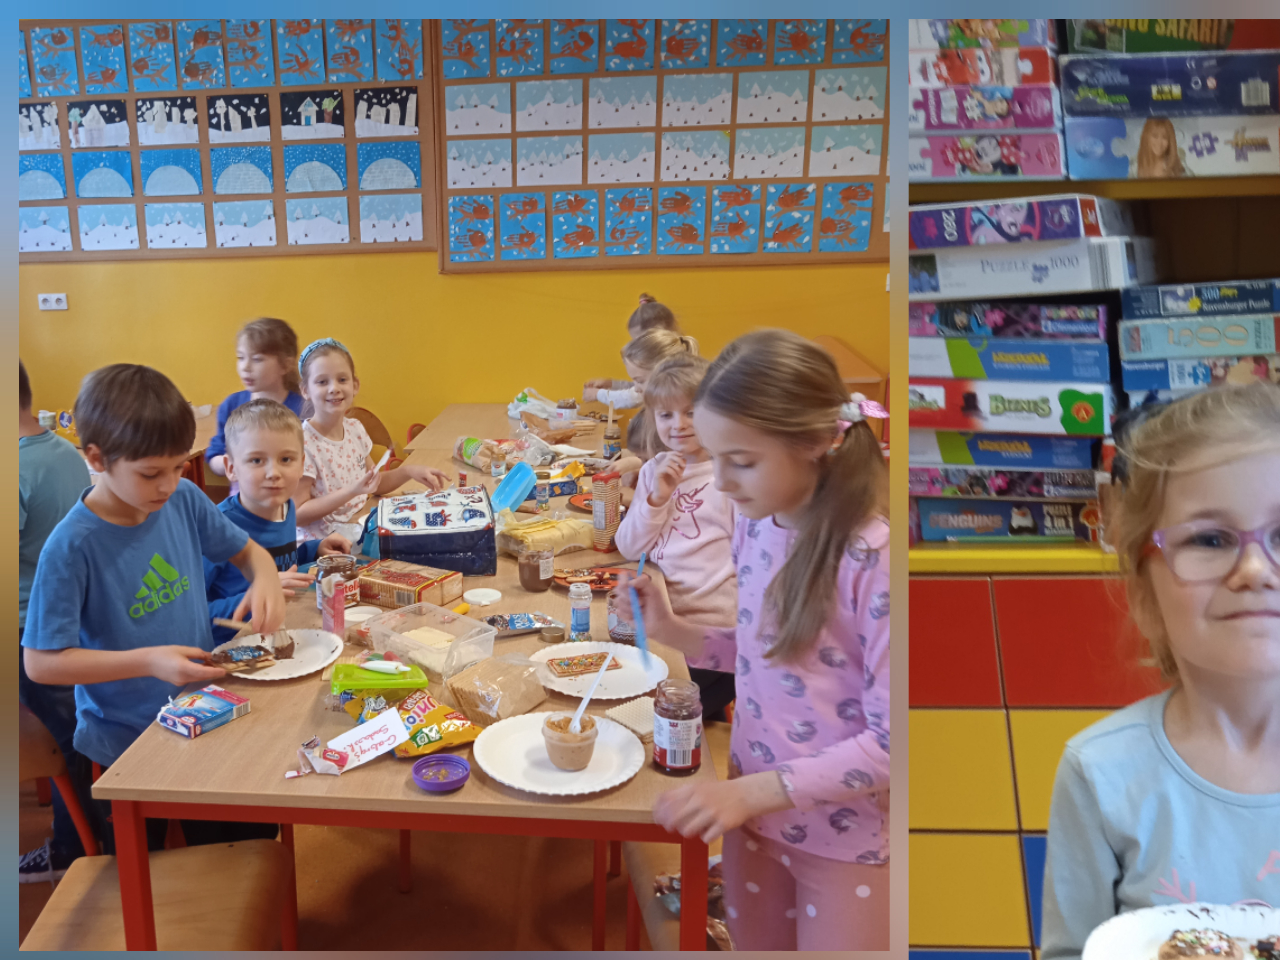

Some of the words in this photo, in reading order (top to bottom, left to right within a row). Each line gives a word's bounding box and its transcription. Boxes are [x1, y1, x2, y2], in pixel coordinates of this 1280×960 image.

[942, 210, 958, 242] 260
[981, 258, 1030, 275] PUZZLE
[1050, 256, 1080, 271] 1000
[1167, 324, 1249, 348] 500
[928, 514, 1003, 529] PENGUINS
[129, 576, 190, 619] adidas
